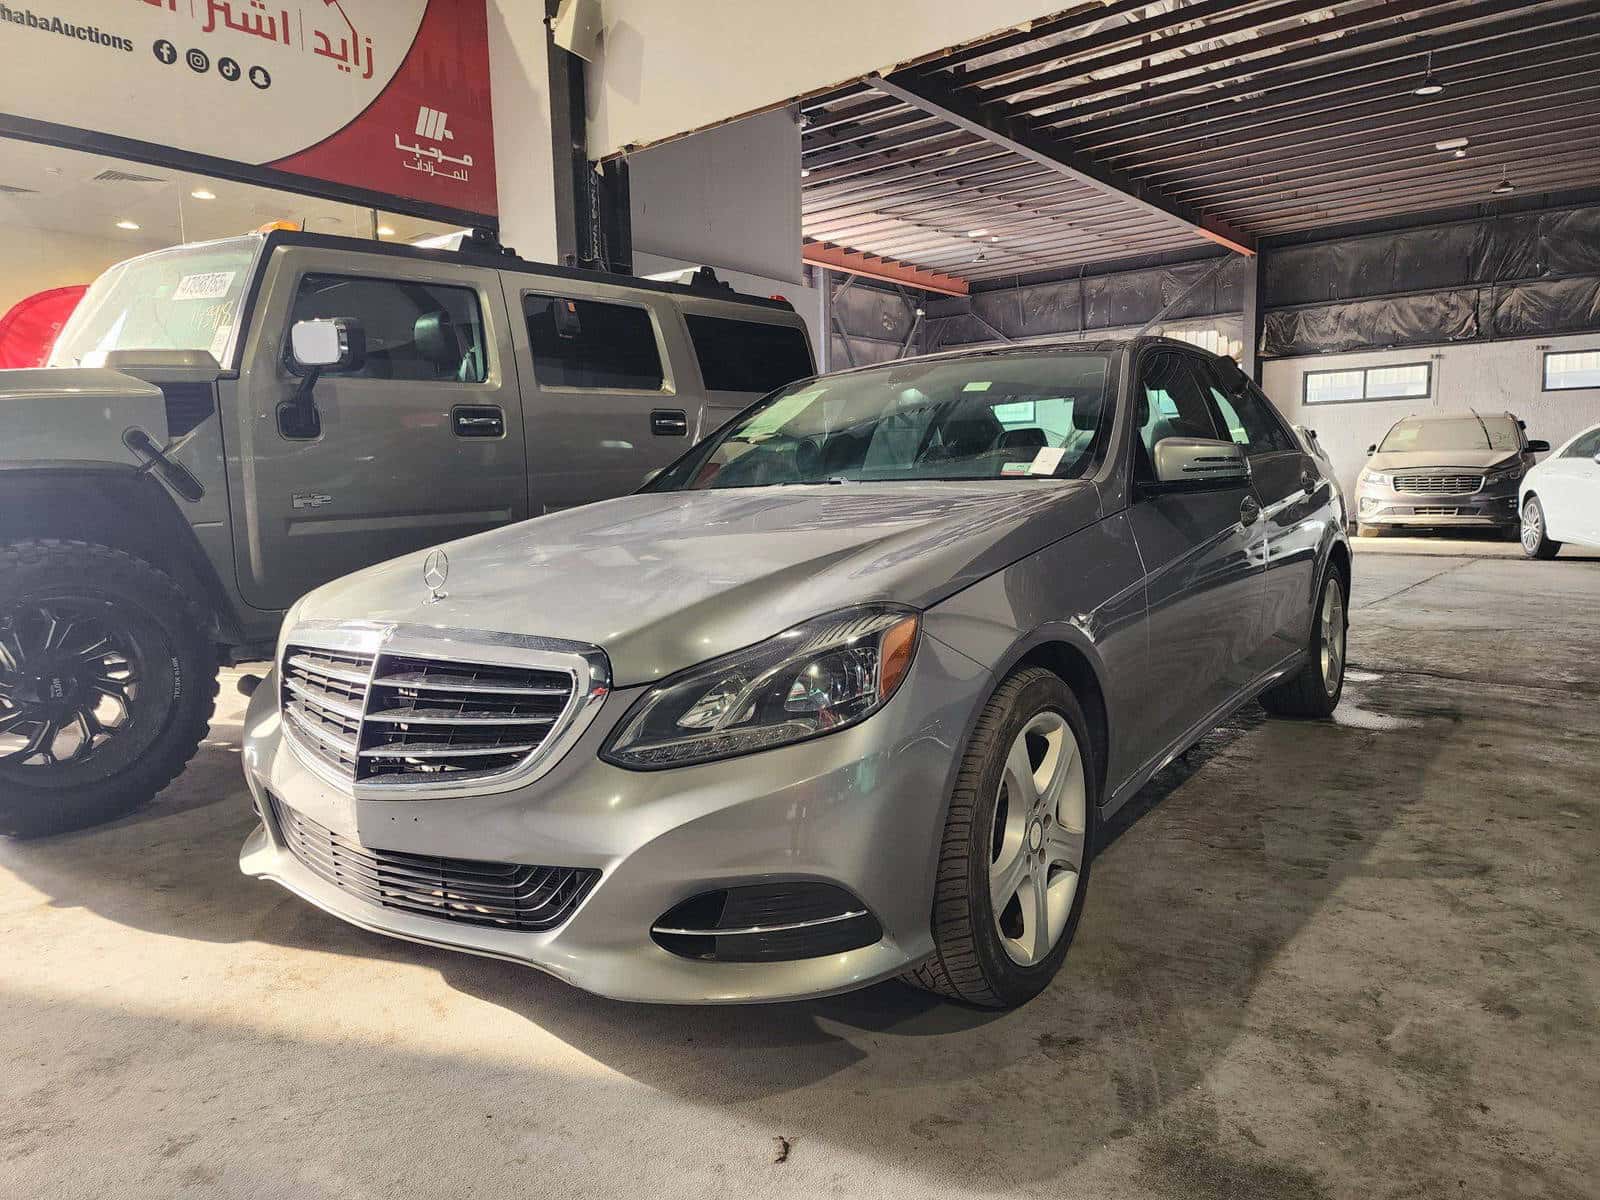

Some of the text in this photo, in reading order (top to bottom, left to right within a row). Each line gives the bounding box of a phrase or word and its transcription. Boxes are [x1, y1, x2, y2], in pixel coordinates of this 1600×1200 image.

[314, 28, 375, 79] زايد
[394, 133, 473, 167] مرحبا
[403, 157, 469, 181] للمزادات
